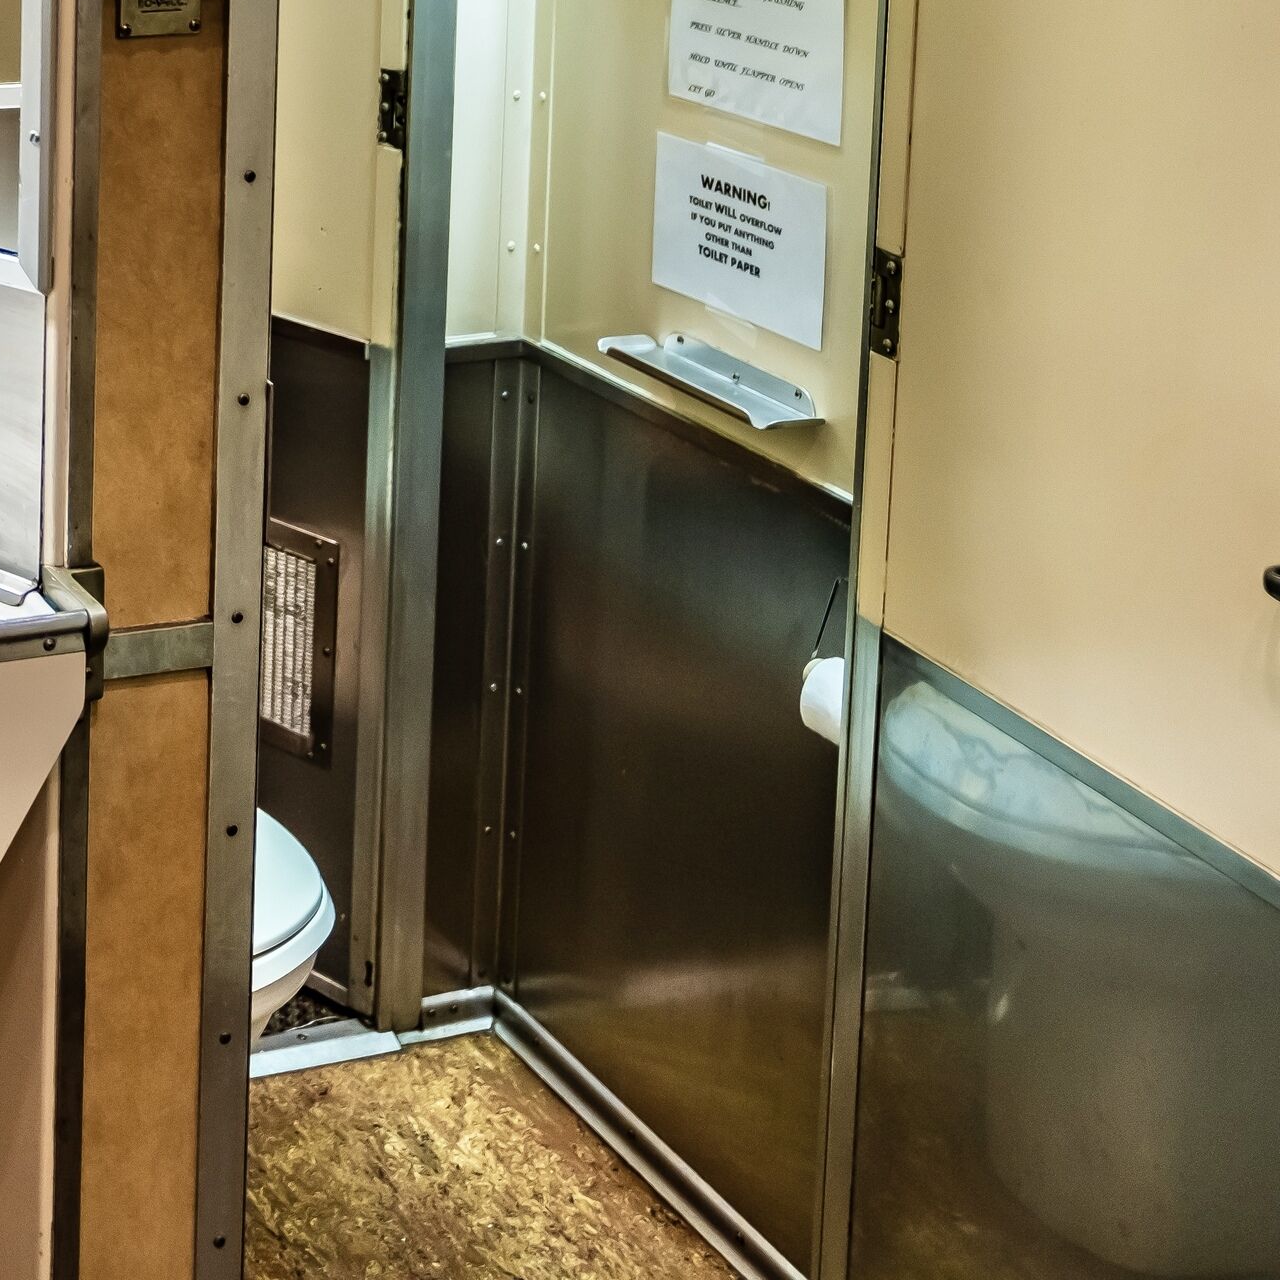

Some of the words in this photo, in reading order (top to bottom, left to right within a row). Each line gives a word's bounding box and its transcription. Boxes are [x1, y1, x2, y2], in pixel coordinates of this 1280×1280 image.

[689, 21, 712, 33] PRESS
[715, 27, 742, 41] SILVER
[745, 34, 780, 50] HANDLE
[782, 44, 809, 58] DOWN
[688, 52, 711, 64] HOLD
[714, 59, 738, 72] UNTIL
[740, 66, 777, 83] FLAPPER
[779, 77, 806, 91] OPENS
[688, 84, 702, 94] LET
[705, 89, 716, 97] GO
[701, 174, 770, 211] WARNING!
[689, 195, 713, 210] TOILET
[715, 202, 737, 219] WILL
[740, 214, 782, 235] OVERFLOW
[691, 212, 698, 220] IF
[699, 215, 716, 228] YOU
[718, 222, 732, 233] PUT
[734, 228, 775, 250] ANYTHING
[698, 244, 728, 264] TOILET
[731, 257, 760, 278] PAPER
[705, 232, 729, 248] OTHER
[731, 241, 752, 256] THAN
